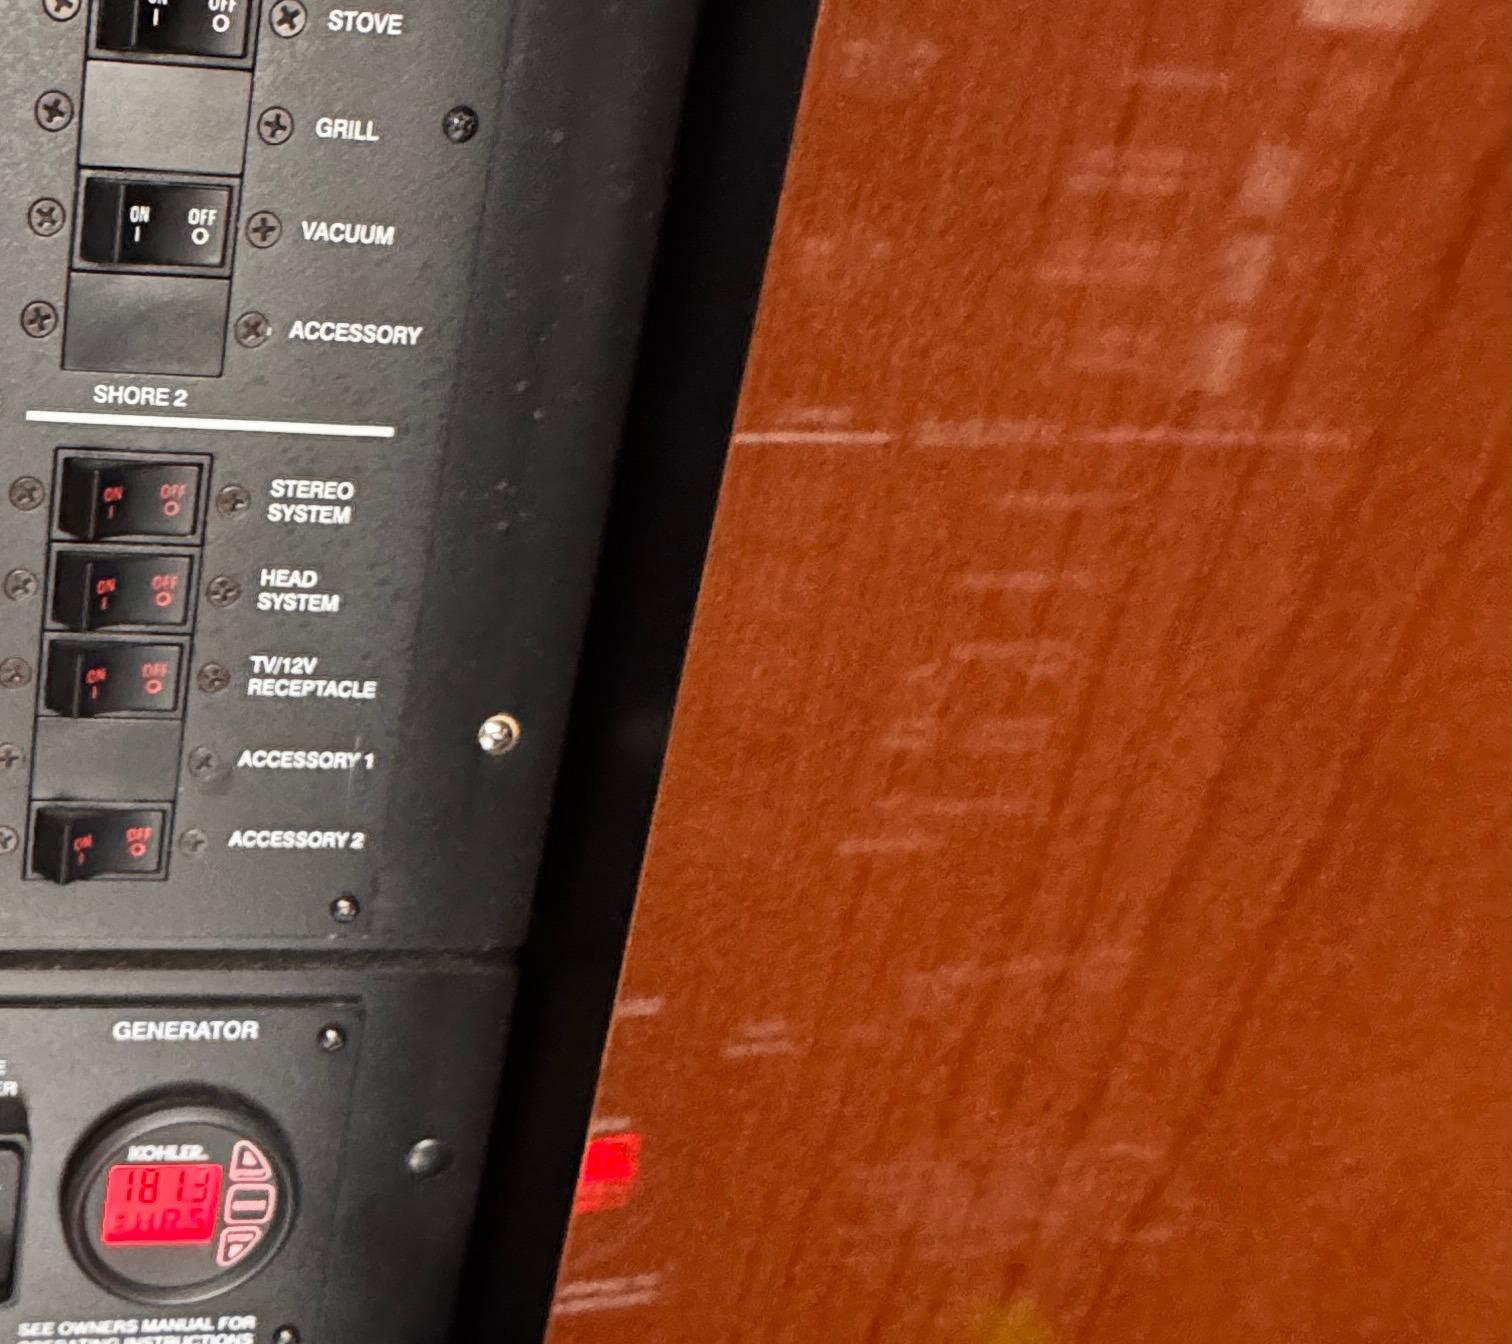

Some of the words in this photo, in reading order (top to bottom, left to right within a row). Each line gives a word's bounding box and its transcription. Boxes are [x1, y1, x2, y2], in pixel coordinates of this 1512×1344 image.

[328, 10, 403, 36] STOVE
[316, 117, 379, 142] GRILL
[130, 205, 151, 224] ON
[188, 207, 217, 227] OFF
[301, 222, 396, 246] VACUUM
[288, 321, 423, 346] ACCESSORY
[93, 385, 170, 408] SHORE
[174, 389, 189, 409] 2
[103, 486, 123, 502] ON
[160, 483, 186, 499] OFF
[270, 479, 355, 501] STEREO
[267, 504, 351, 524] SYSTEM
[96, 577, 116, 595] ON
[152, 574, 178, 591] OFF
[260, 570, 318, 588] HEAD
[257, 593, 340, 612] SYSTEM
[86, 667, 107, 685] ON
[142, 663, 168, 679] OFF
[250, 656, 318, 675] TV/12V
[247, 679, 377, 700] RECEPTACLE
[237, 751, 359, 769] ACCESSORY
[364, 751, 375, 768] 1
[73, 834, 93, 852] ON
[126, 828, 152, 844] OFF
[228, 831, 347, 849] ACCESSORY
[350, 832, 364, 849] 2
[112, 1021, 260, 1041] GENERATOR
[17, 1321, 56, 1337] SEE
[57, 1319, 139, 1336] OWNERS
[140, 1316, 215, 1334] MANUAL
[217, 1315, 257, 1331] FOR
